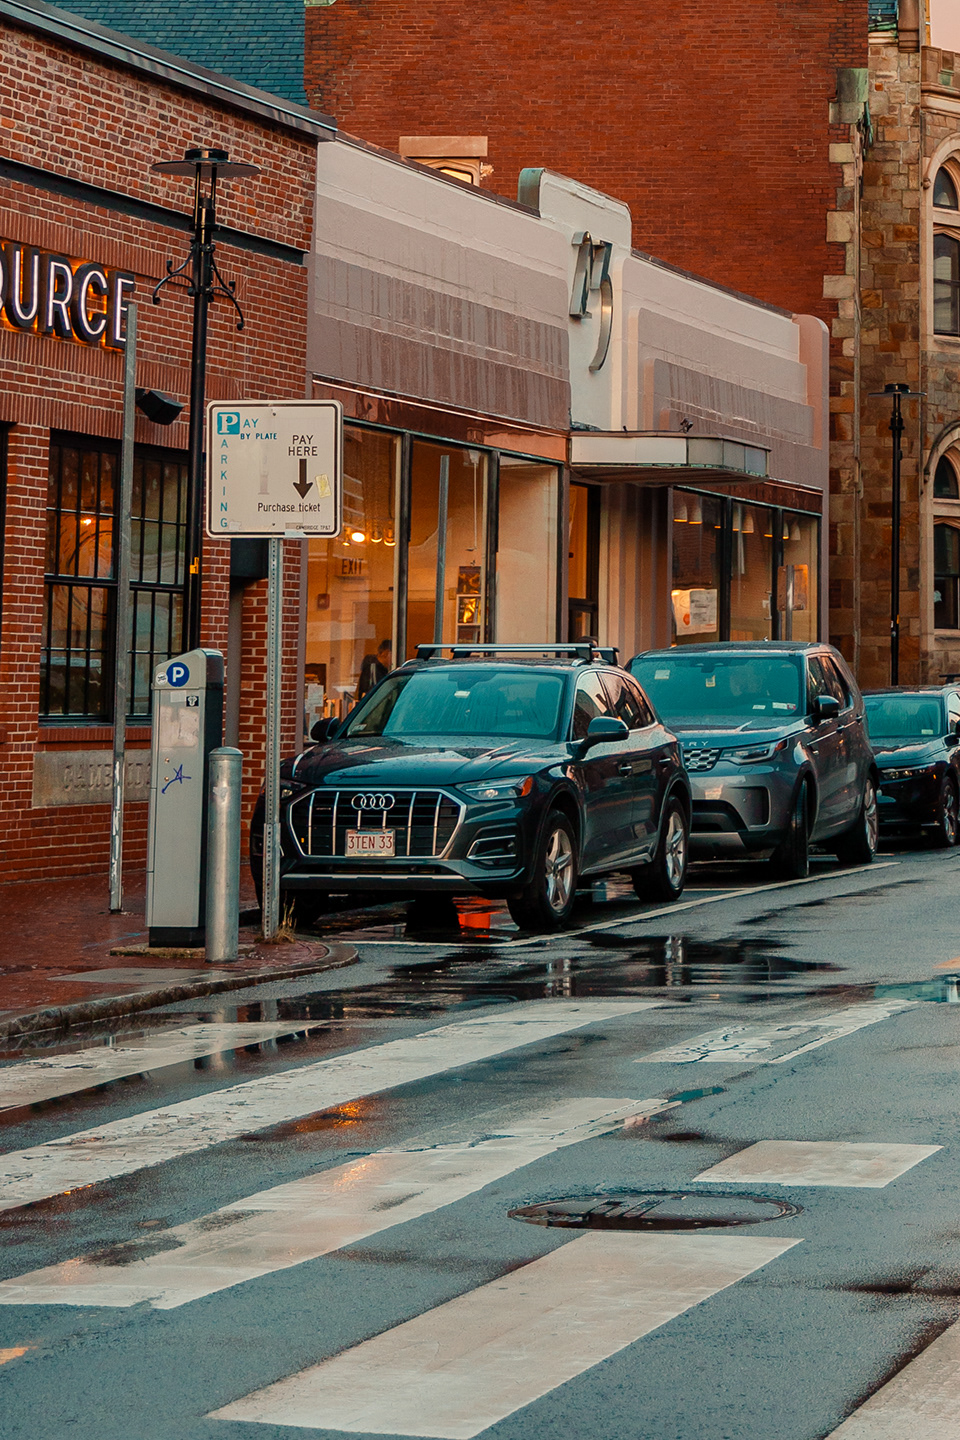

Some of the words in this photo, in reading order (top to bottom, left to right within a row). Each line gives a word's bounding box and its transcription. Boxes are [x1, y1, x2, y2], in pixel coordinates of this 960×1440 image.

[0, 243, 135, 350] URCE
[292, 435, 314, 445] PAY
[288, 446, 318, 457] HERE
[257, 503, 296, 512] Purchase
[298, 503, 321, 512] ticket
[341, 558, 364, 575] EXIT
[172, 666, 185, 683] P
[348, 835, 376, 849] 3TEN
[378, 835, 393, 849] 33
